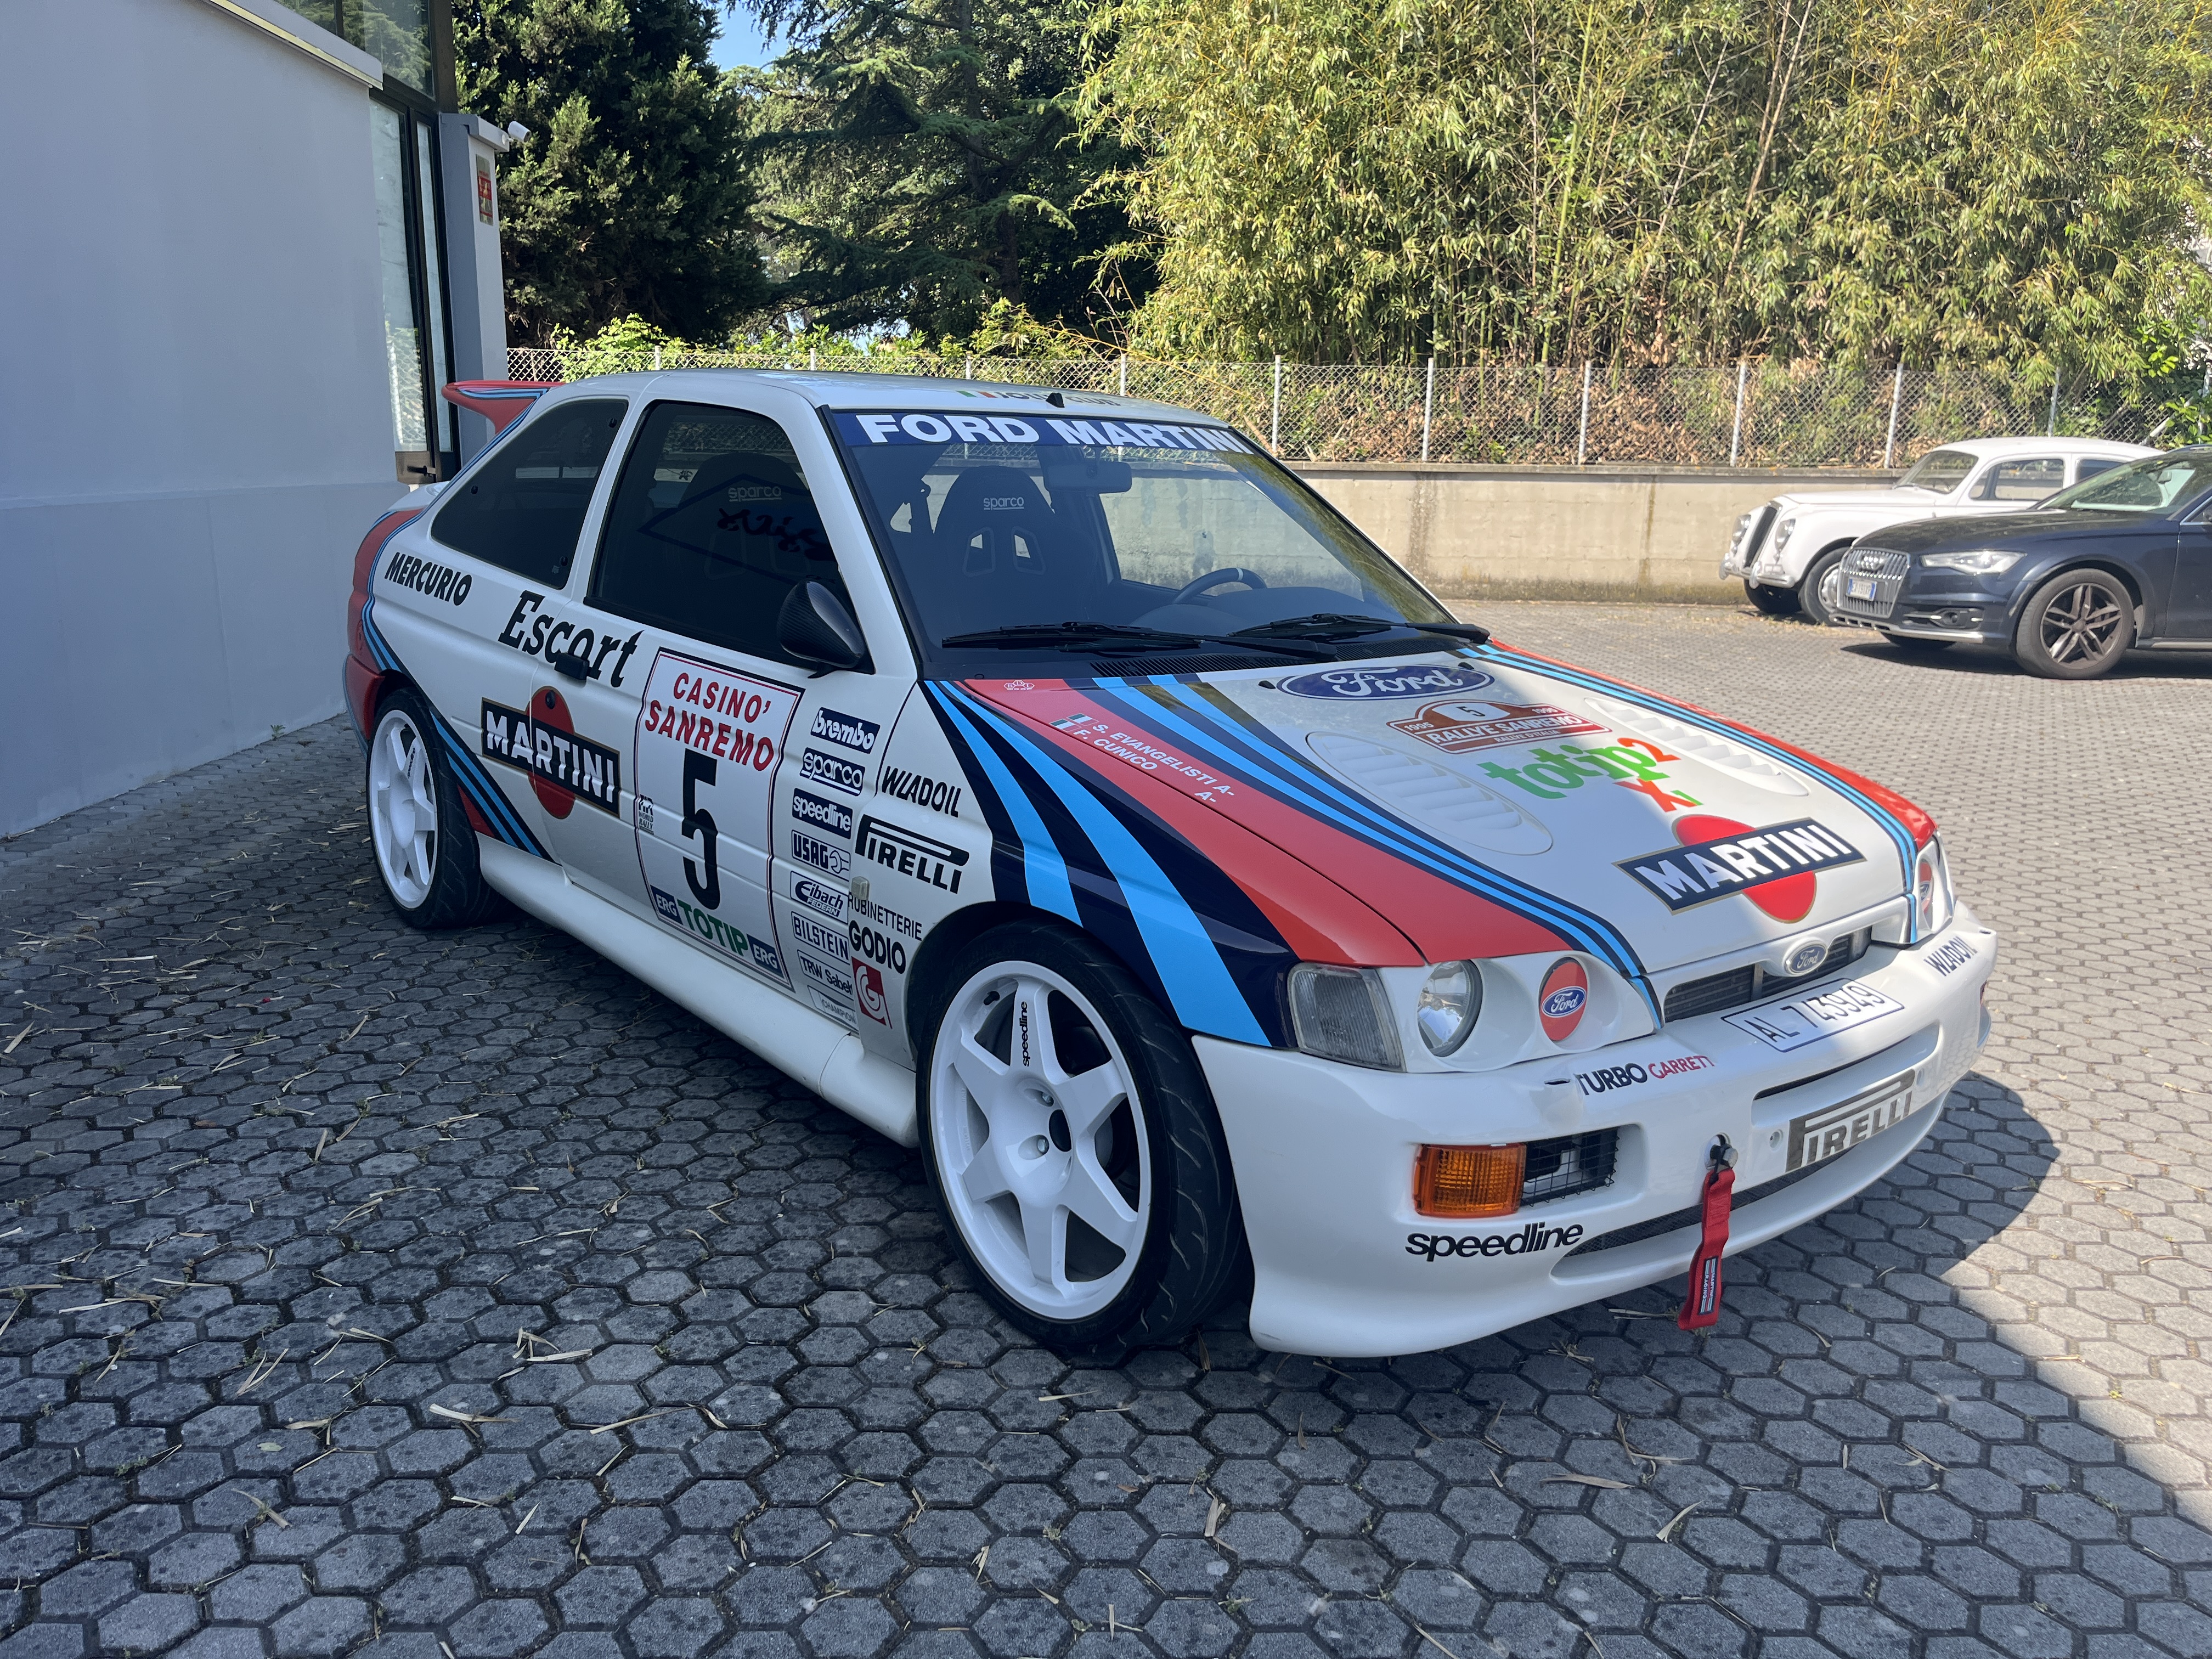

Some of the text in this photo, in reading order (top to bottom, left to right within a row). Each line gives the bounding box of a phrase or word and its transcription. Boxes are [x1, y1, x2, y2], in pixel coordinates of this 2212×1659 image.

[856, 414, 1256, 455] FORD MARTINI
[728, 486, 782, 501] sparco
[983, 496, 1024, 510] sparco
[385, 552, 472, 606] MERCURIO
[498, 590, 645, 687] Escort
[673, 672, 771, 723] CASINO'
[1321, 667, 1463, 697] Ford
[811, 709, 874, 750] brembo
[1404, 721, 1434, 732] 1995
[1426, 715, 1584, 743] RALLYE SANREMO
[1456, 706, 1486, 718] 5
[645, 700, 774, 771] SANREMO
[1494, 733, 1525, 743] RALLYE
[486, 710, 615, 803] MARTINI
[803, 752, 863, 788] sparco
[1073, 729, 1217, 803] F. CUNICO A-
[1093, 723, 1235, 797] S. EVANGELISTI A-
[1476, 744, 1671, 799] totip
[882, 766, 961, 818] WLADOIL
[639, 811, 654, 823] WORLD
[639, 818, 654, 830] RALLY
[681, 748, 720, 910] 5
[793, 795, 851, 832] speedline
[793, 833, 828, 870] USAG
[855, 815, 969, 894] PIRELLI
[1634, 823, 1853, 902] MARTINI
[795, 881, 844, 910] Eibach
[806, 898, 840, 917] FEDERN
[848, 891, 922, 941] RUBINETTERIE
[656, 894, 778, 969] ERG TOTIP ERG
[793, 916, 849, 961] BILSTEIN
[849, 919, 906, 974] GODIO
[800, 956, 823, 980] TRW
[1797, 949, 1820, 969] Ford
[822, 998, 856, 1024] CHAMPION
[1550, 991, 1579, 1013] Ford
[1019, 1001, 1030, 1066] speedline
[1743, 1016, 1801, 1043] AL
[1573, 1054, 1716, 1096] TURBO GARRETT
[1787, 1068, 1917, 1173] PIRELLI
[1405, 1222, 1584, 1262] speedline
